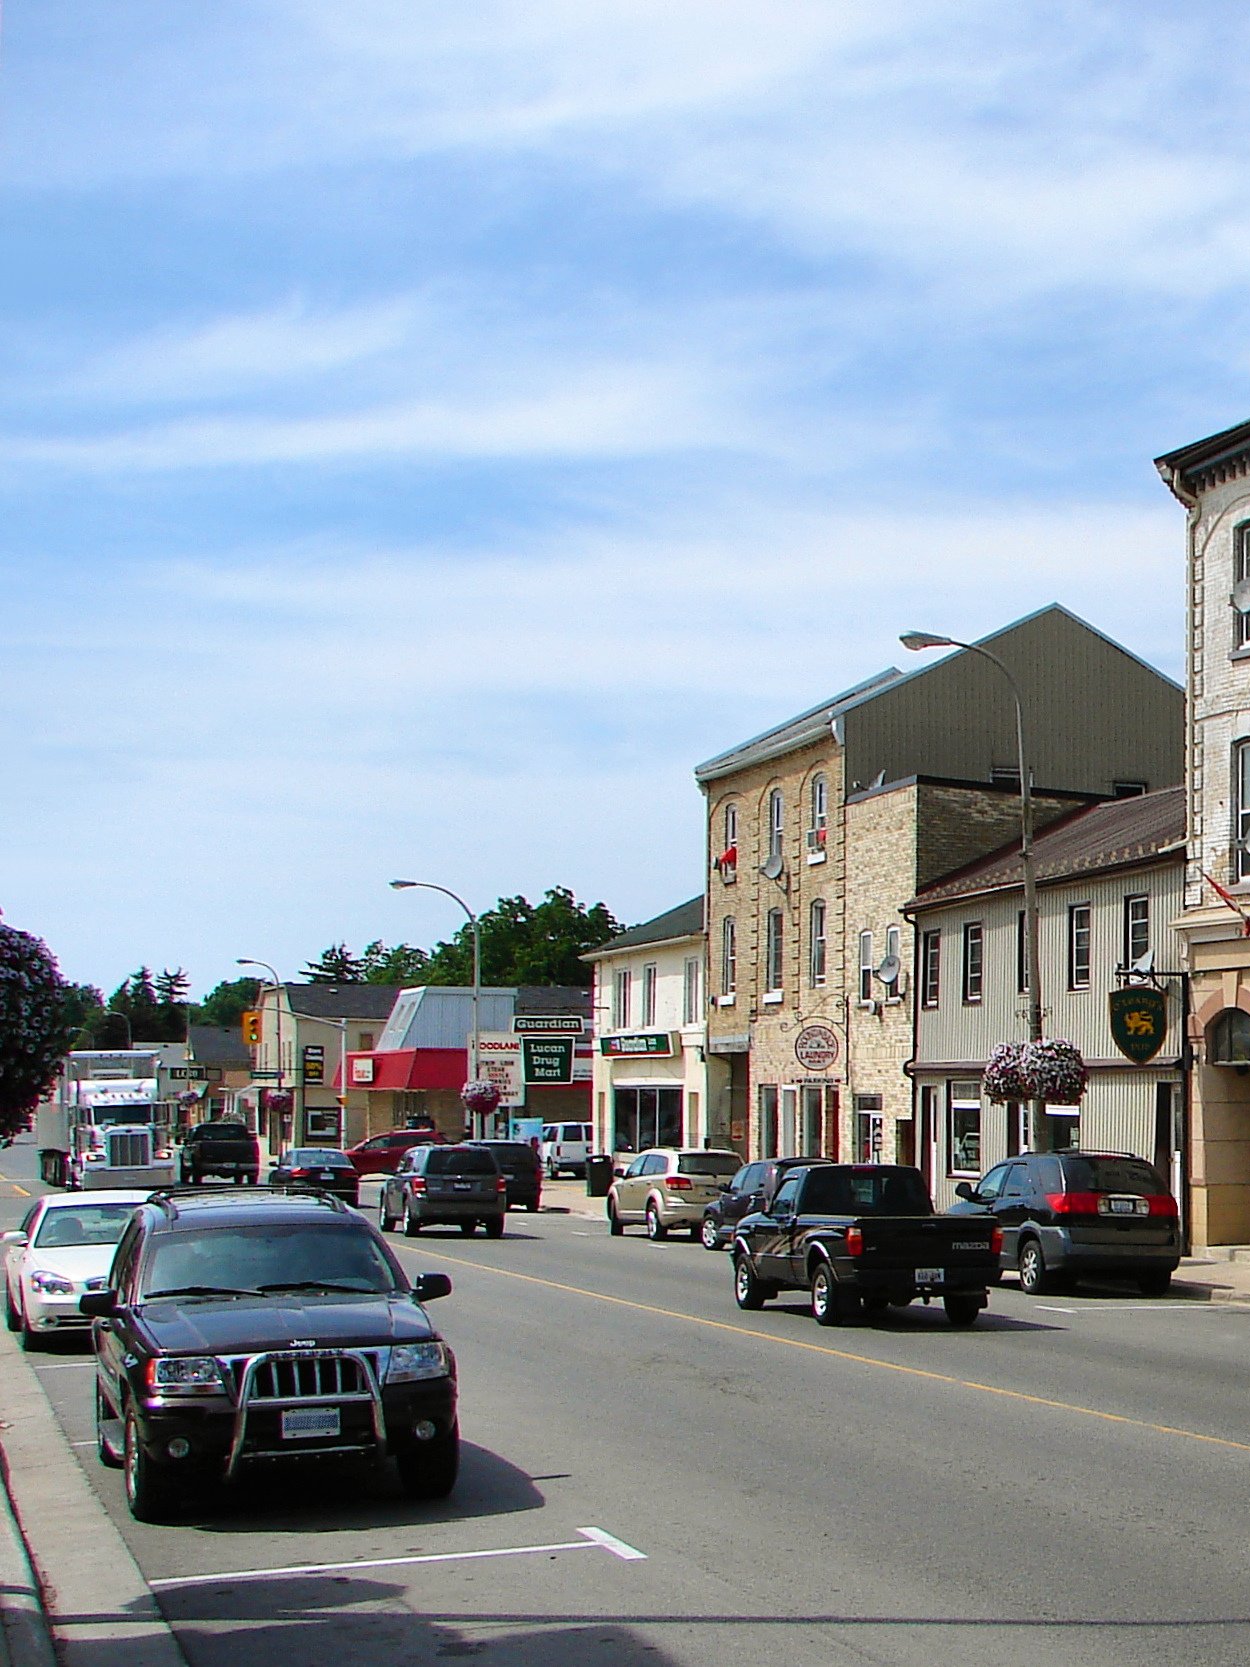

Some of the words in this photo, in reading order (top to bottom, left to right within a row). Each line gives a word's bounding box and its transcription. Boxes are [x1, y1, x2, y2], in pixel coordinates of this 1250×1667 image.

[516, 1019, 579, 1029] Guardian
[530, 1043, 566, 1053] Lucan
[532, 1056, 560, 1067] Drug
[534, 1068, 561, 1077] Mart
[952, 1241, 990, 1250] mazda
[289, 1339, 316, 1348] Jeep
